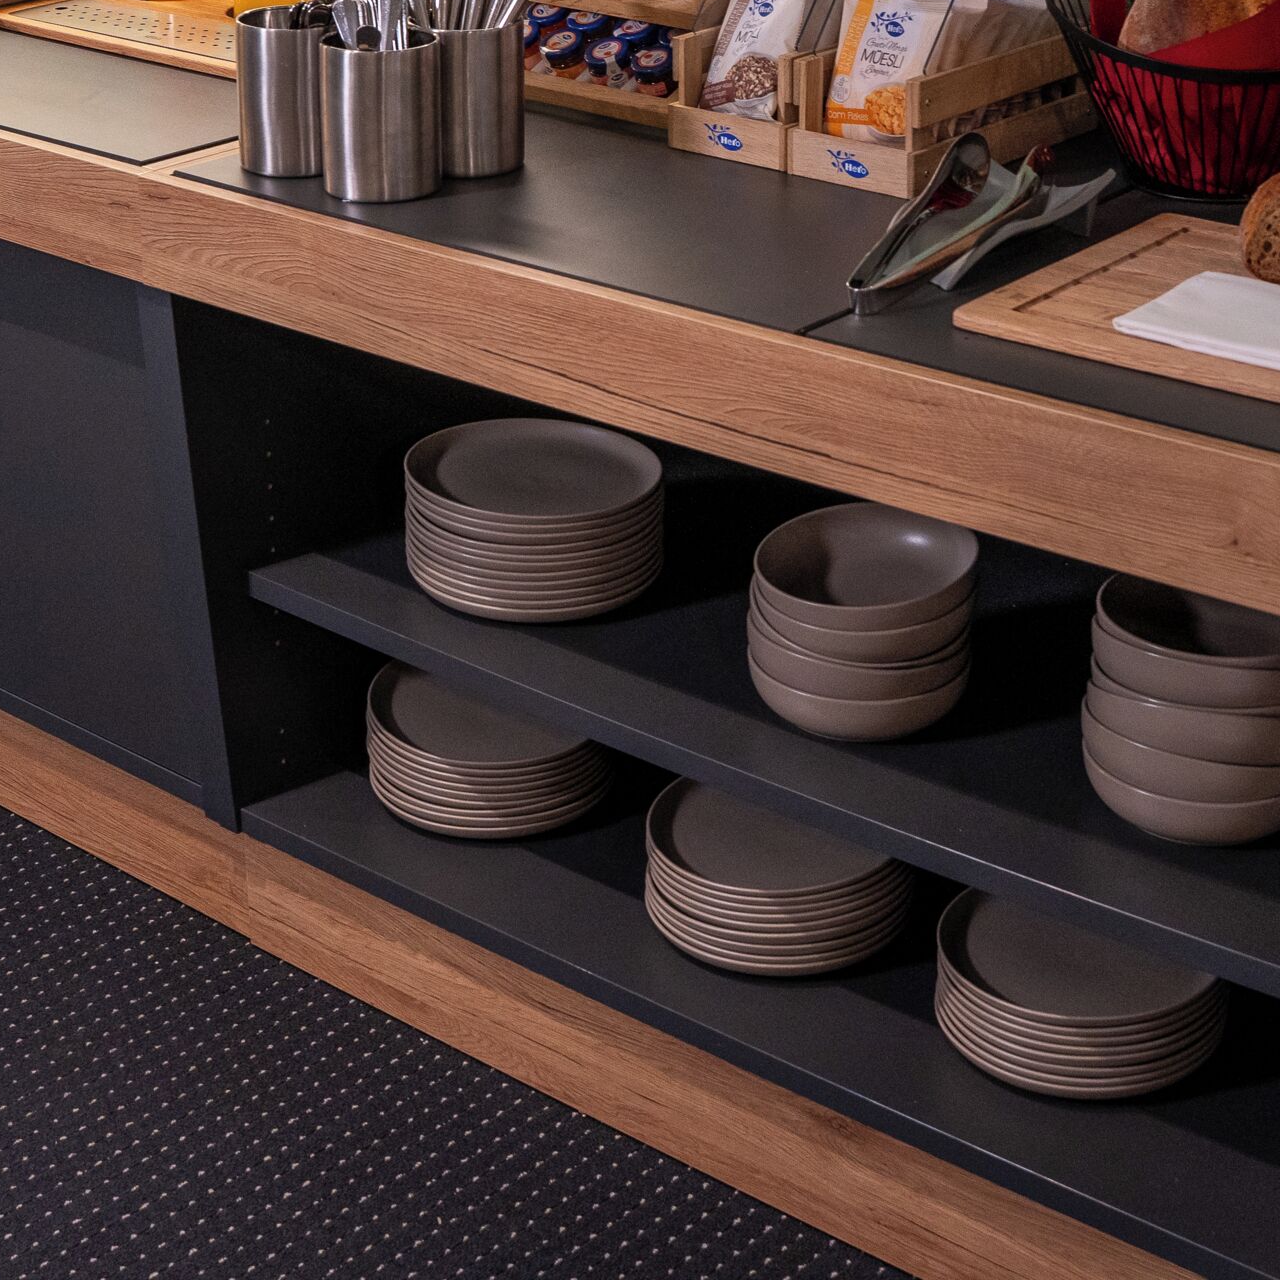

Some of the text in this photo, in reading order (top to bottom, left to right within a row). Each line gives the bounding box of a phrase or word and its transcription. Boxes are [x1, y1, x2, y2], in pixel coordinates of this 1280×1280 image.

[860, 48, 905, 69] MÜESLI
[721, 136, 741, 148] Hero
[845, 162, 867, 175] Hero
